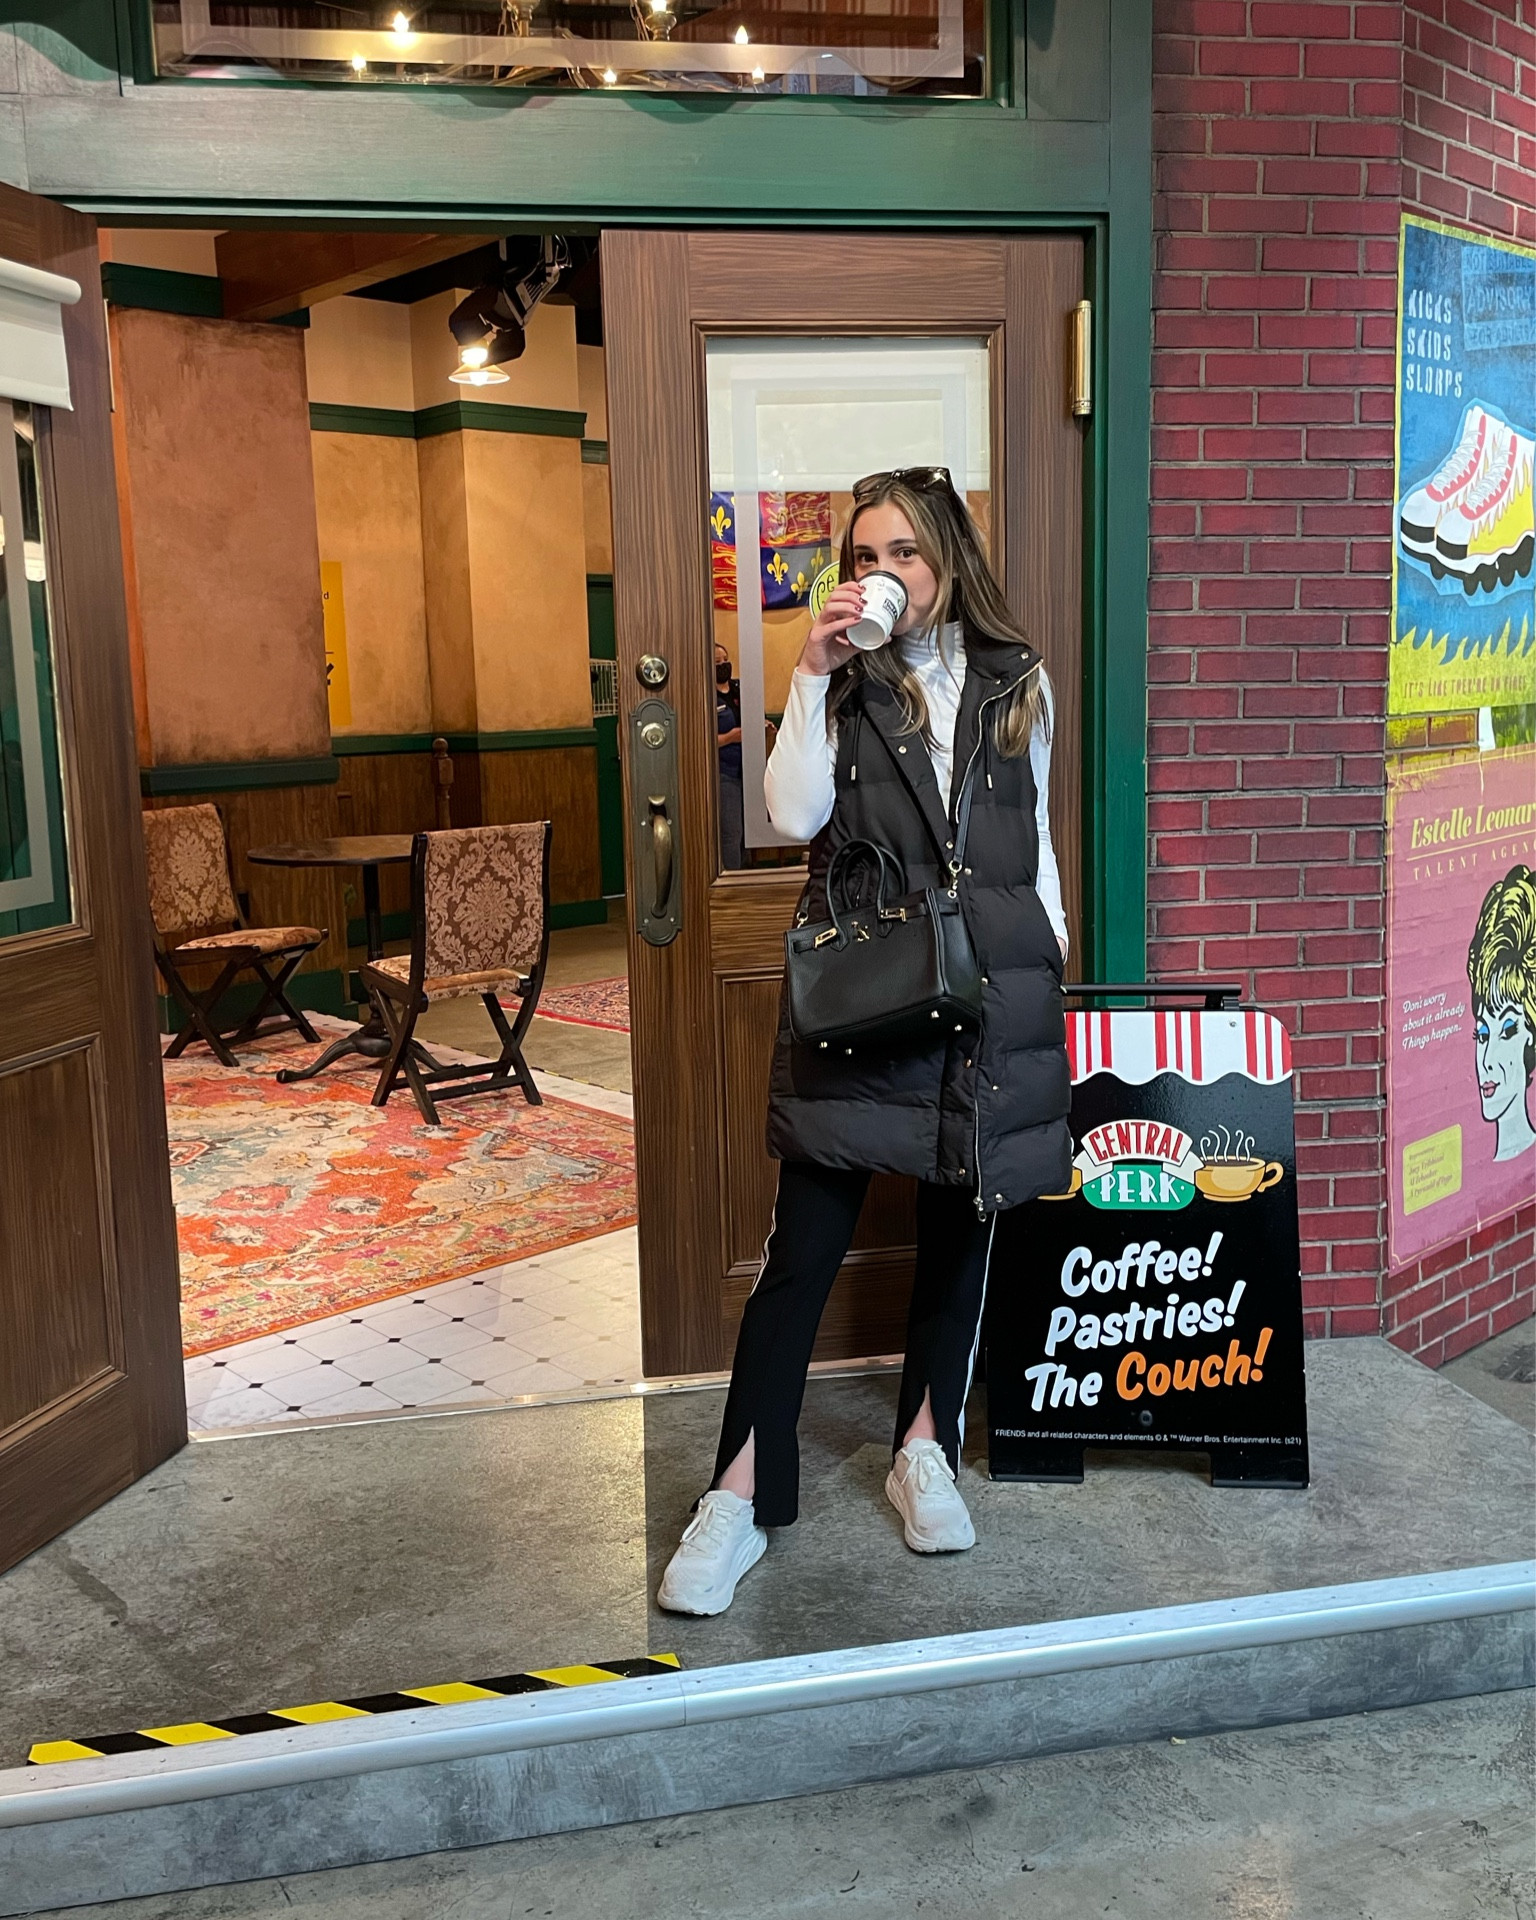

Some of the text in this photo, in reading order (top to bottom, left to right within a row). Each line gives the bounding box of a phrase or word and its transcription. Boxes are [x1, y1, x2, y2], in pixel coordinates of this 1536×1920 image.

[1408, 289, 1452, 324] KICKS
[1467, 285, 1532, 314] ADVISORY
[1407, 327, 1452, 361] SKIDS
[1406, 363, 1463, 399] SLORPS
[1403, 682, 1424, 699] IT'S
[1428, 677, 1448, 697] LIKE
[1411, 807, 1472, 849] Estelle
[1413, 853, 1477, 881] TALENT
[1424, 992, 1447, 1006] worry
[1402, 1017, 1424, 1032] about
[1434, 1001, 1466, 1022] already
[1402, 1034, 1430, 1050] Things
[1088, 1121, 1184, 1162] CENTRAL
[1100, 1169, 1181, 1203] PERK
[1060, 1231, 1224, 1297] Coffee!
[1044, 1279, 1247, 1356] Pastries!
[1024, 1327, 1274, 1412] The Couch!
[995, 1429, 1026, 1438] FRIENDS
[1027, 1430, 1040, 1438] and
[1041, 1430, 1049, 1438] all
[1050, 1431, 1073, 1439] related
[1074, 1432, 1108, 1440] characters
[1110, 1433, 1122, 1441] and
[1124, 1433, 1154, 1441] elements
[1179, 1434, 1203, 1442] Warner
[1204, 1435, 1221, 1443] Bros.
[1223, 1436, 1270, 1444] Entertainment
[1271, 1436, 1282, 1444] Inc.
[1284, 1437, 1302, 1446] (s21)
